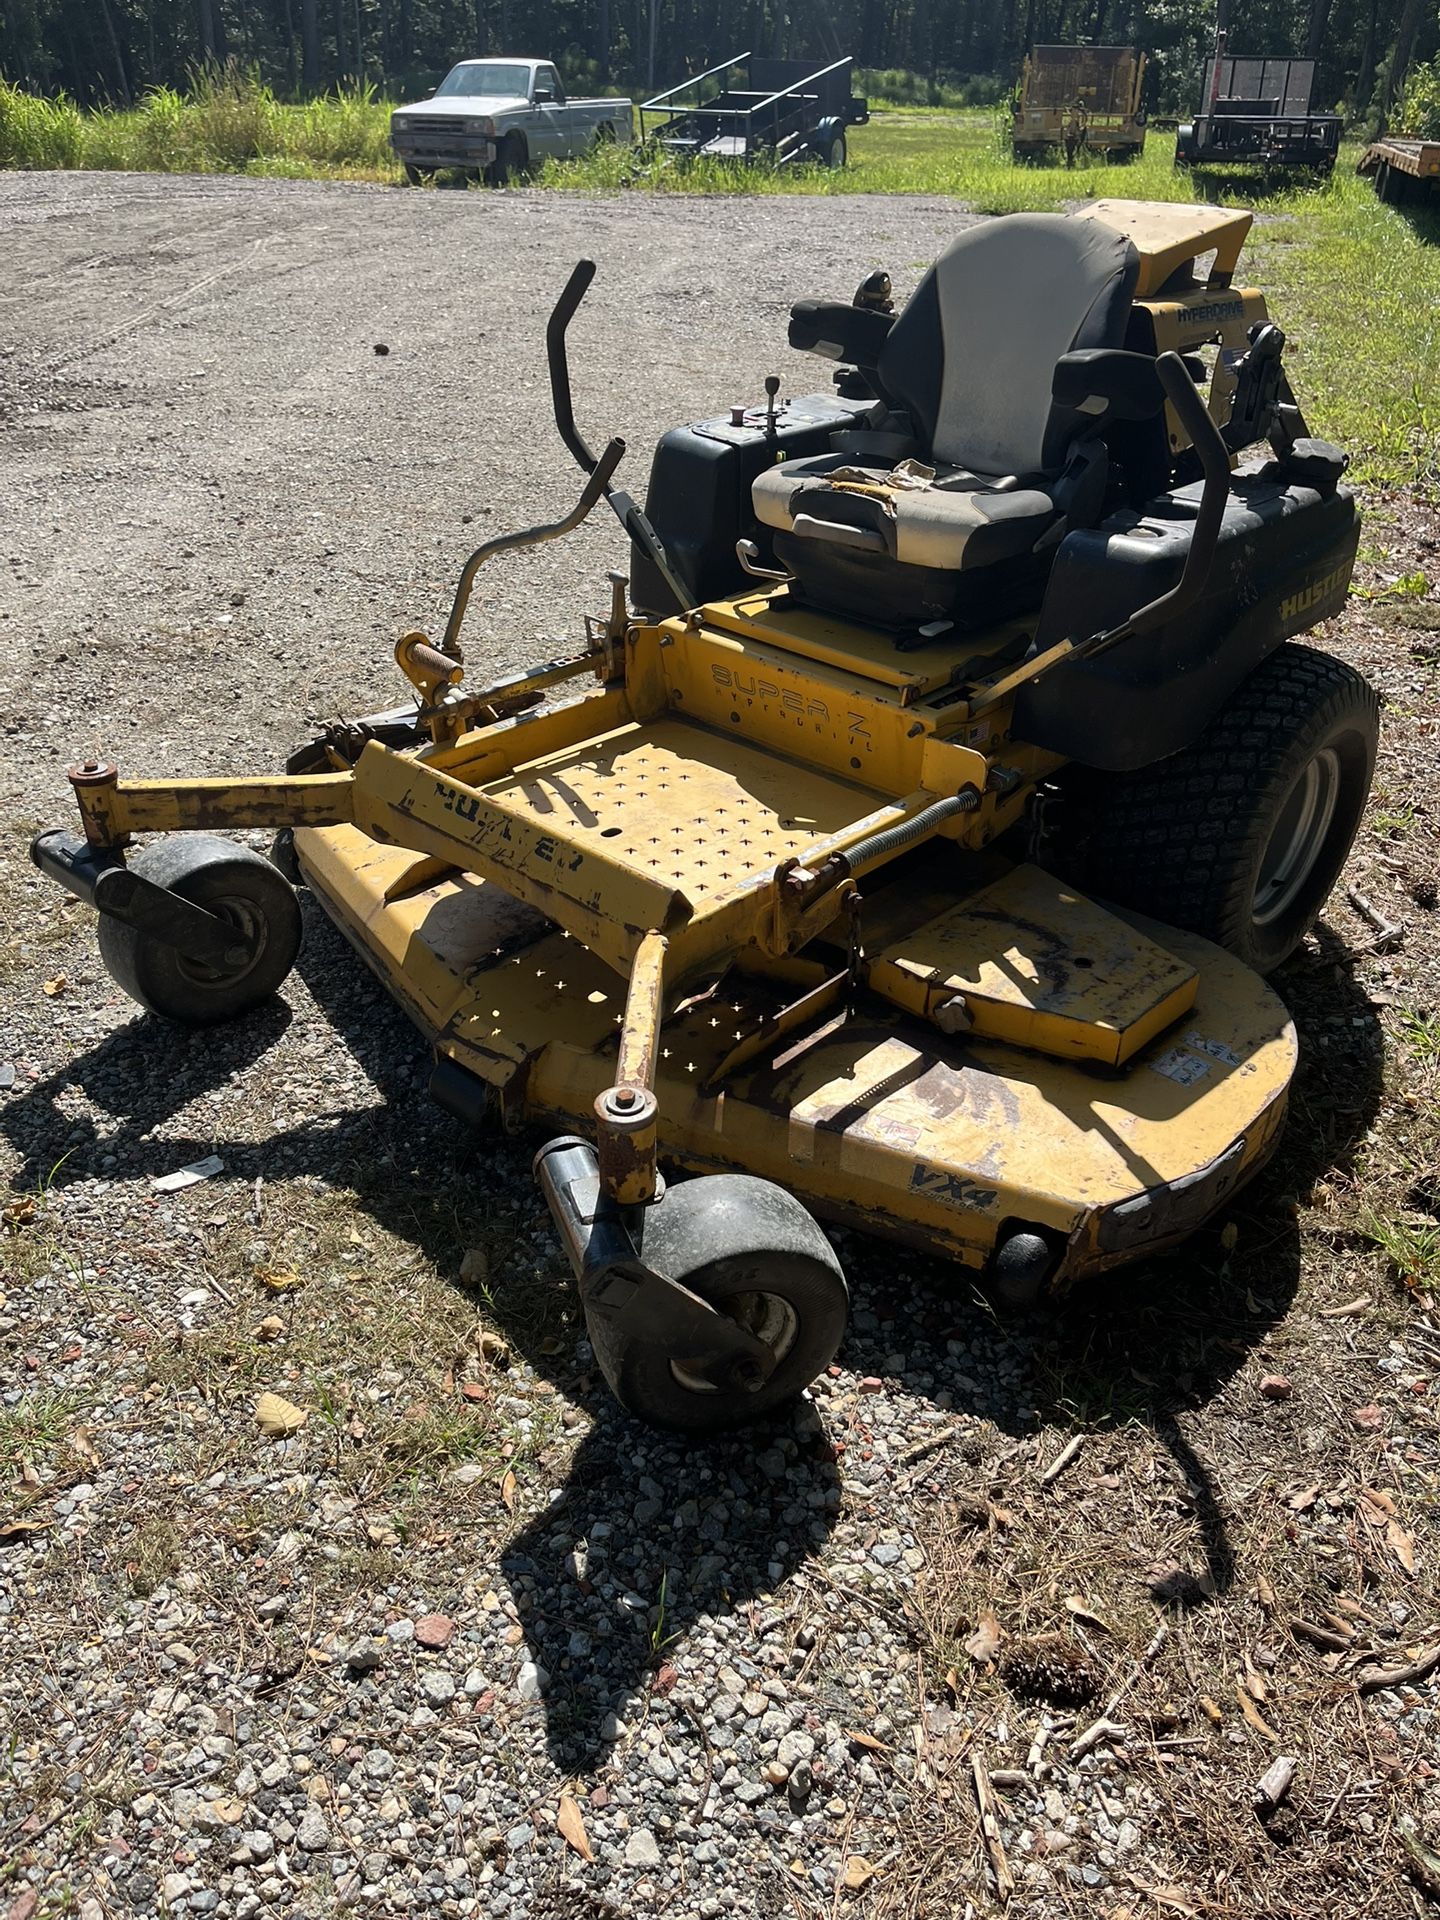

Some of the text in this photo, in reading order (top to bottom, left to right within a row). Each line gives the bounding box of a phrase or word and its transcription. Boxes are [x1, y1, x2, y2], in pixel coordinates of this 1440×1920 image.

[1177, 300, 1244, 322] HYPERDRIVE
[711, 663, 872, 738] SUPER Z
[911, 1163, 998, 1208] VX4
